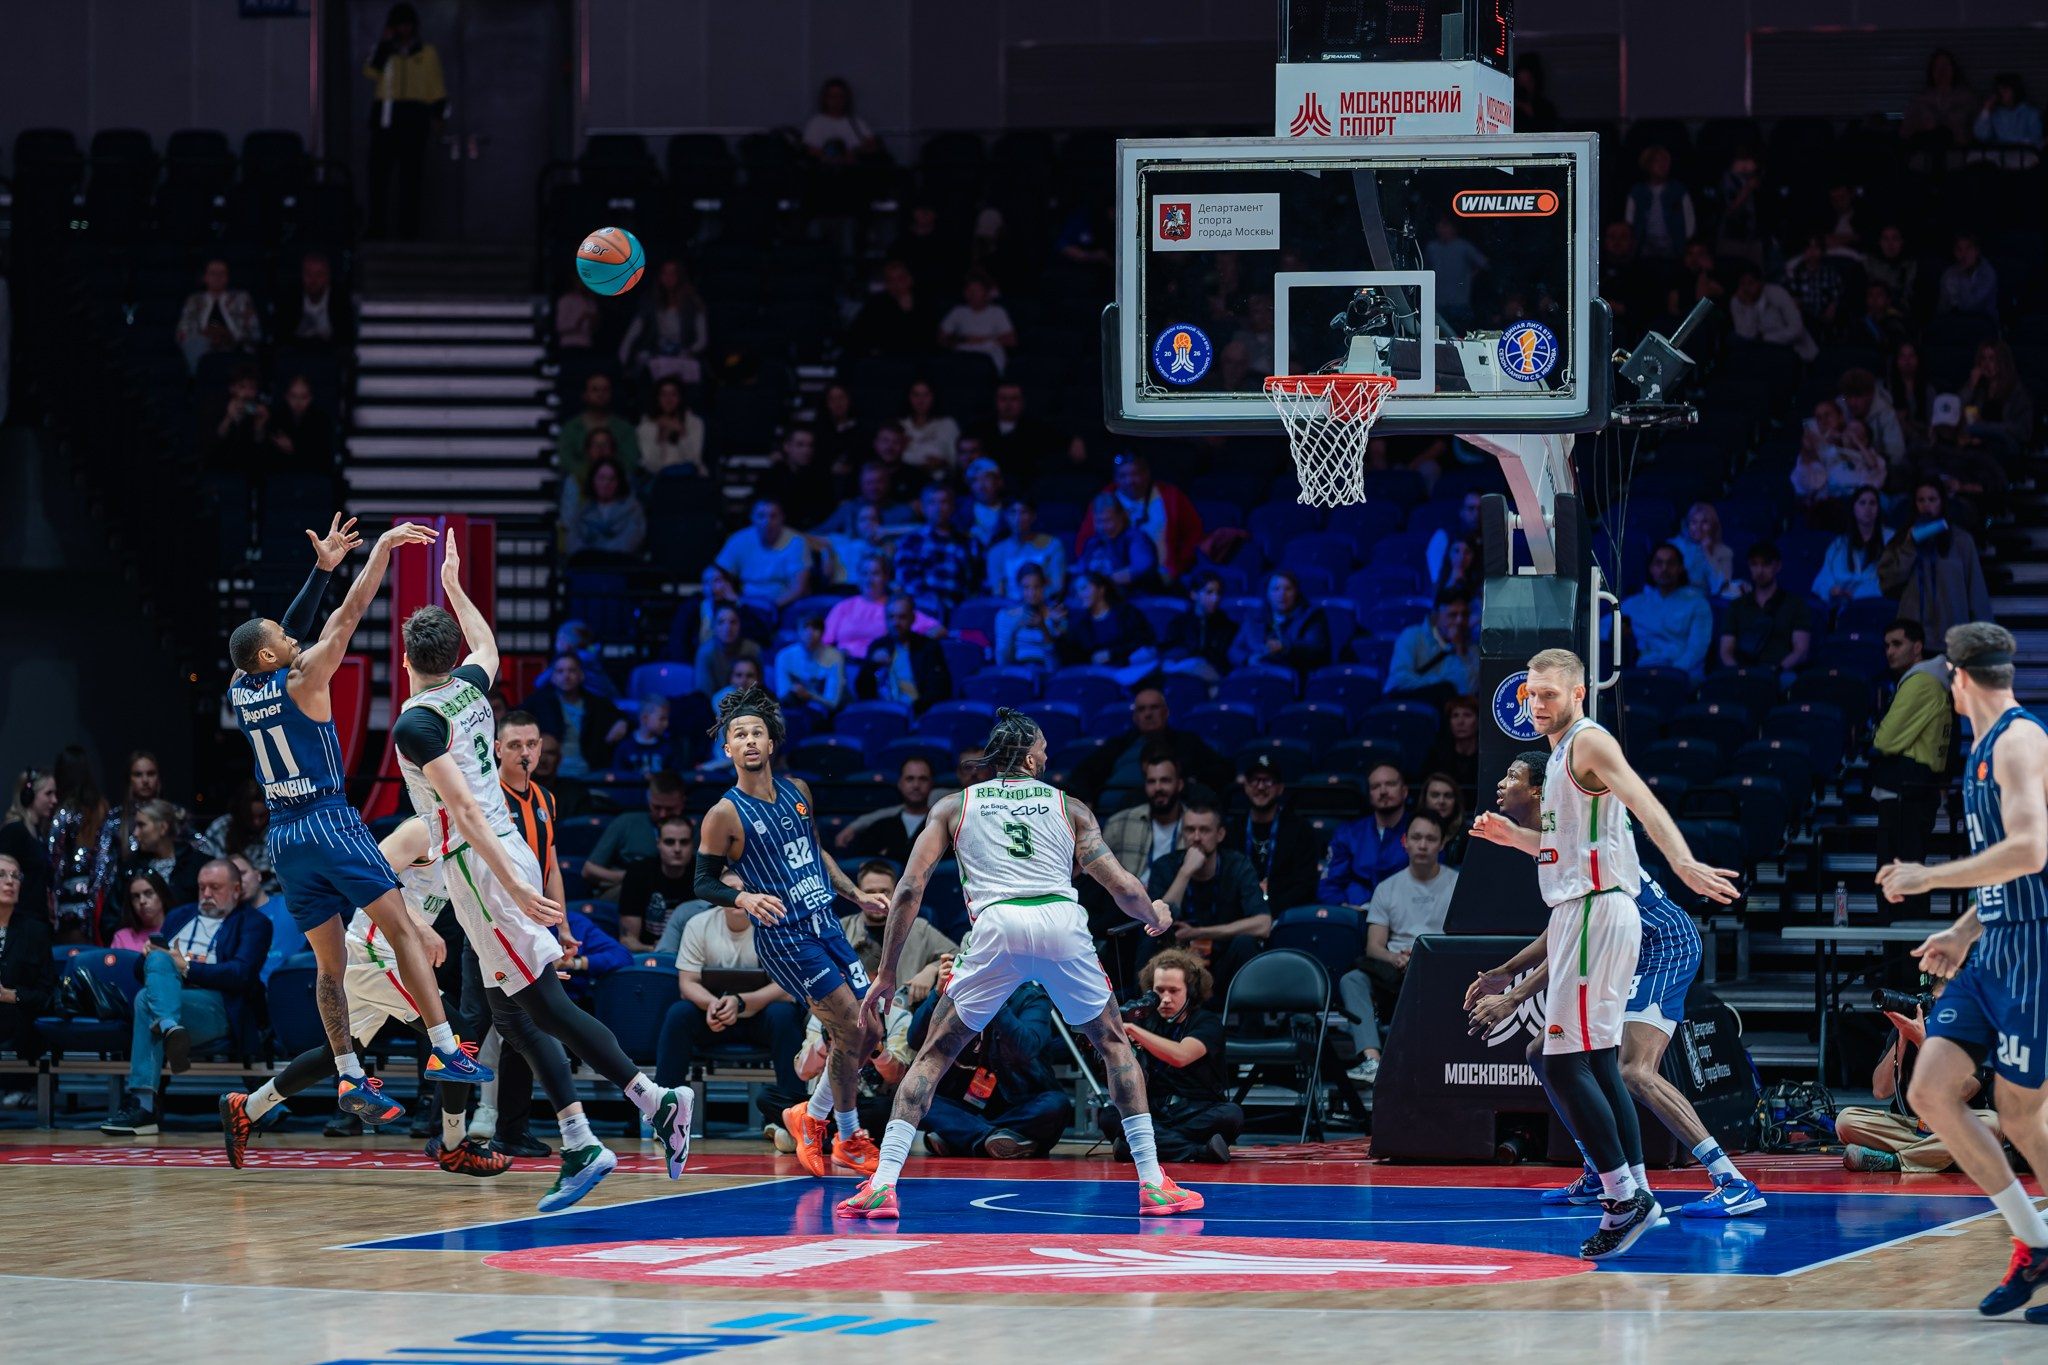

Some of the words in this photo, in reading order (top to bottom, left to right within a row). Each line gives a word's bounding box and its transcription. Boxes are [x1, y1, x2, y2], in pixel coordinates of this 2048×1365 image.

[1340, 85, 1461, 115] МОСКОВСКИЙ
[1340, 116, 1397, 136] СПОРТ
[1198, 203, 1264, 214] Департамент
[1461, 195, 1536, 211] WINLINE
[1198, 217, 1232, 226] спорта
[1198, 228, 1232, 238] города
[1235, 227, 1274, 236] Москвы
[1502, 322, 1526, 341] ЕДИНАЯ
[1526, 322, 1543, 331] ЛИГА
[1542, 328, 1553, 340] ВТБ
[1498, 348, 1509, 369] СЕЗОН
[1505, 367, 1530, 381] ПАМЯТИ
[1540, 347, 1557, 375] ИВАНОВА
[249, 724, 300, 784] 11
[473, 732, 492, 777] 2
[976, 786, 1053, 801] REYNOLDS
[1003, 821, 1035, 860] 3
[782, 836, 814, 870] 32
[1997, 1031, 2031, 1073] 24
[1444, 1062, 1543, 1086] МОСКОВСКИ
